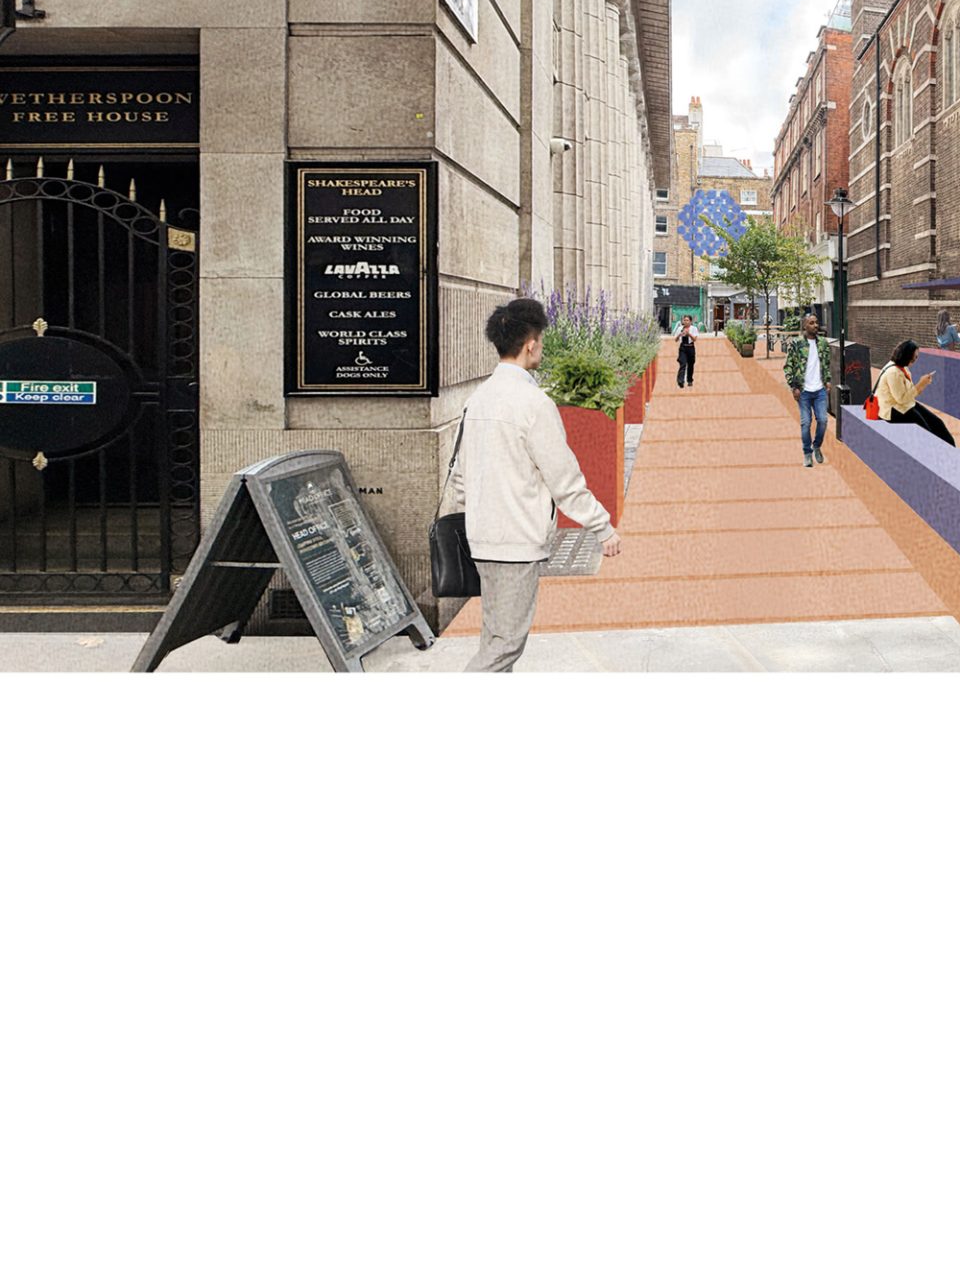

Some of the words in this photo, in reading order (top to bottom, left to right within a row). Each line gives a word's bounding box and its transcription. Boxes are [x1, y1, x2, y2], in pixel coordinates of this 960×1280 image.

[13, 112, 75, 122] FREE
[87, 112, 169, 122] HOUSE
[324, 261, 400, 274] LAVAZZA
[21, 383, 49, 392] Fire
[52, 383, 79, 392] exit
[15, 393, 49, 402] Keep
[52, 393, 85, 401] clear
